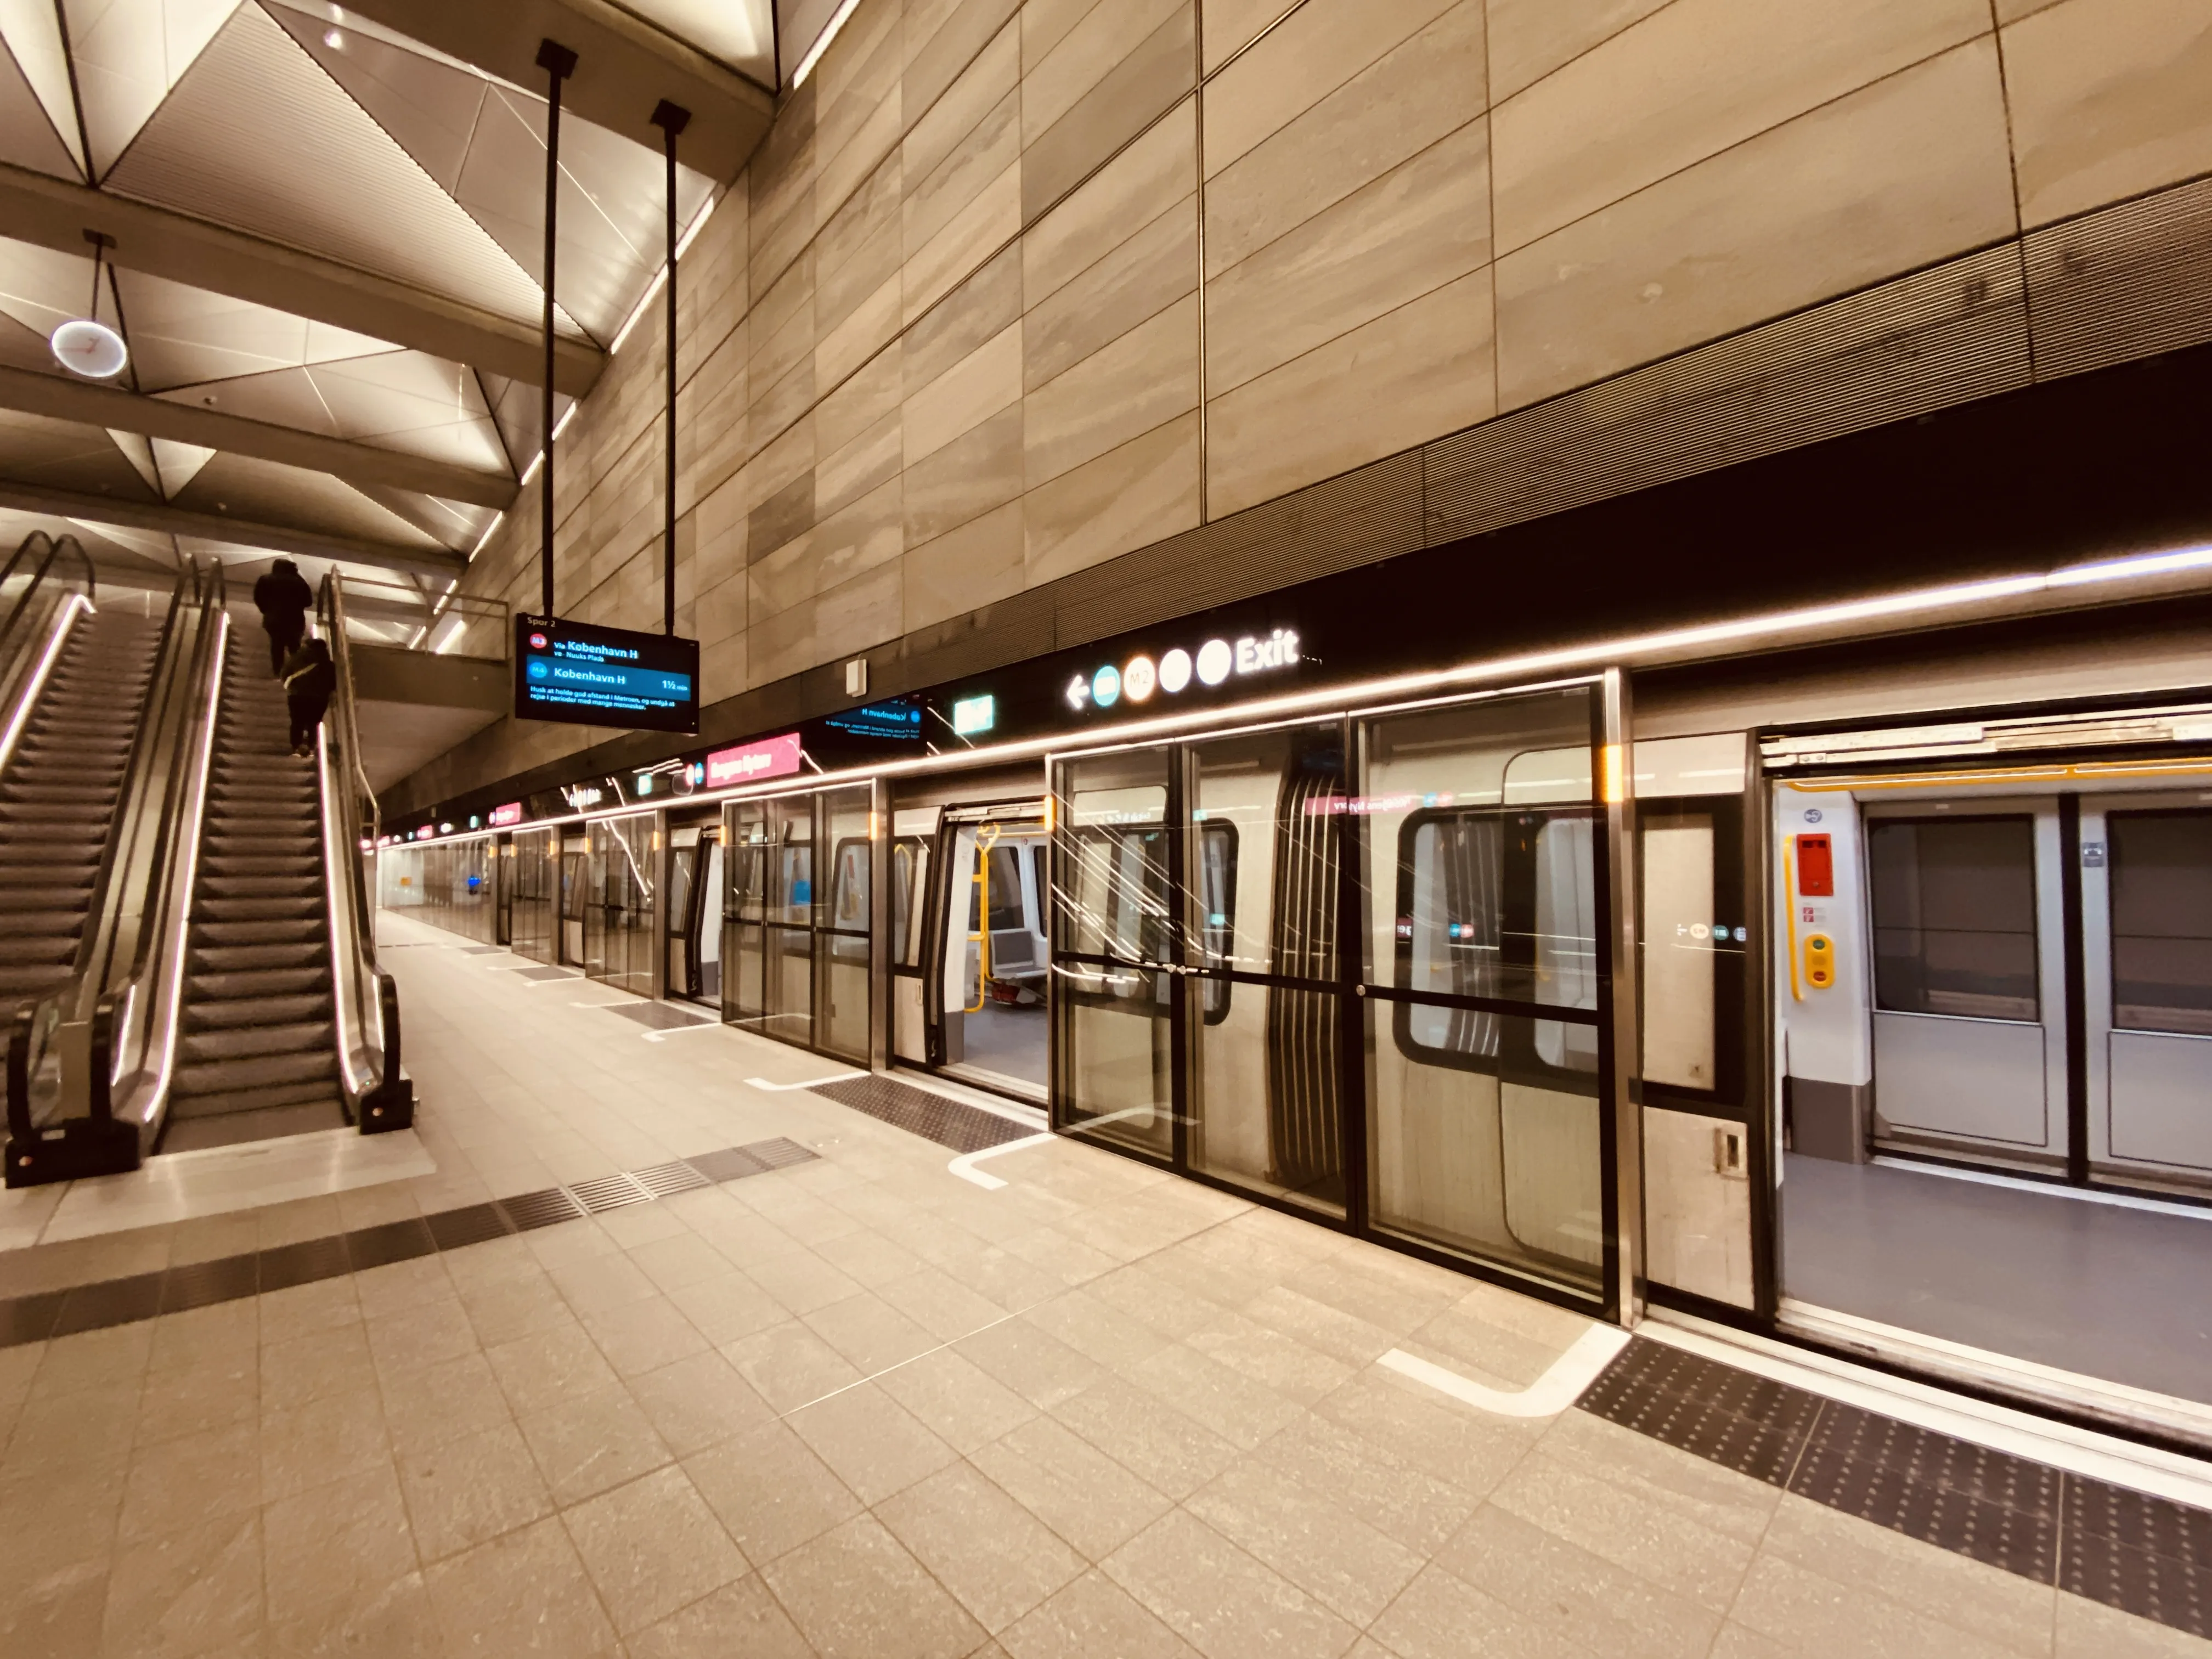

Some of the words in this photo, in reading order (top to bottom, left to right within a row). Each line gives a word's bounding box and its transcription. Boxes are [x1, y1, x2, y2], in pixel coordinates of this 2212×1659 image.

[527, 617, 548, 626] Spor
[532, 636, 545, 645] M3
[567, 641, 627, 658] København
[629, 650, 639, 659] H
[566, 651, 586, 660] Nuuks
[588, 654, 605, 662] Plads
[1130, 670, 1149, 687] M2
[1236, 629, 1299, 673] Exit
[554, 668, 614, 684] København
[617, 675, 626, 685] H
